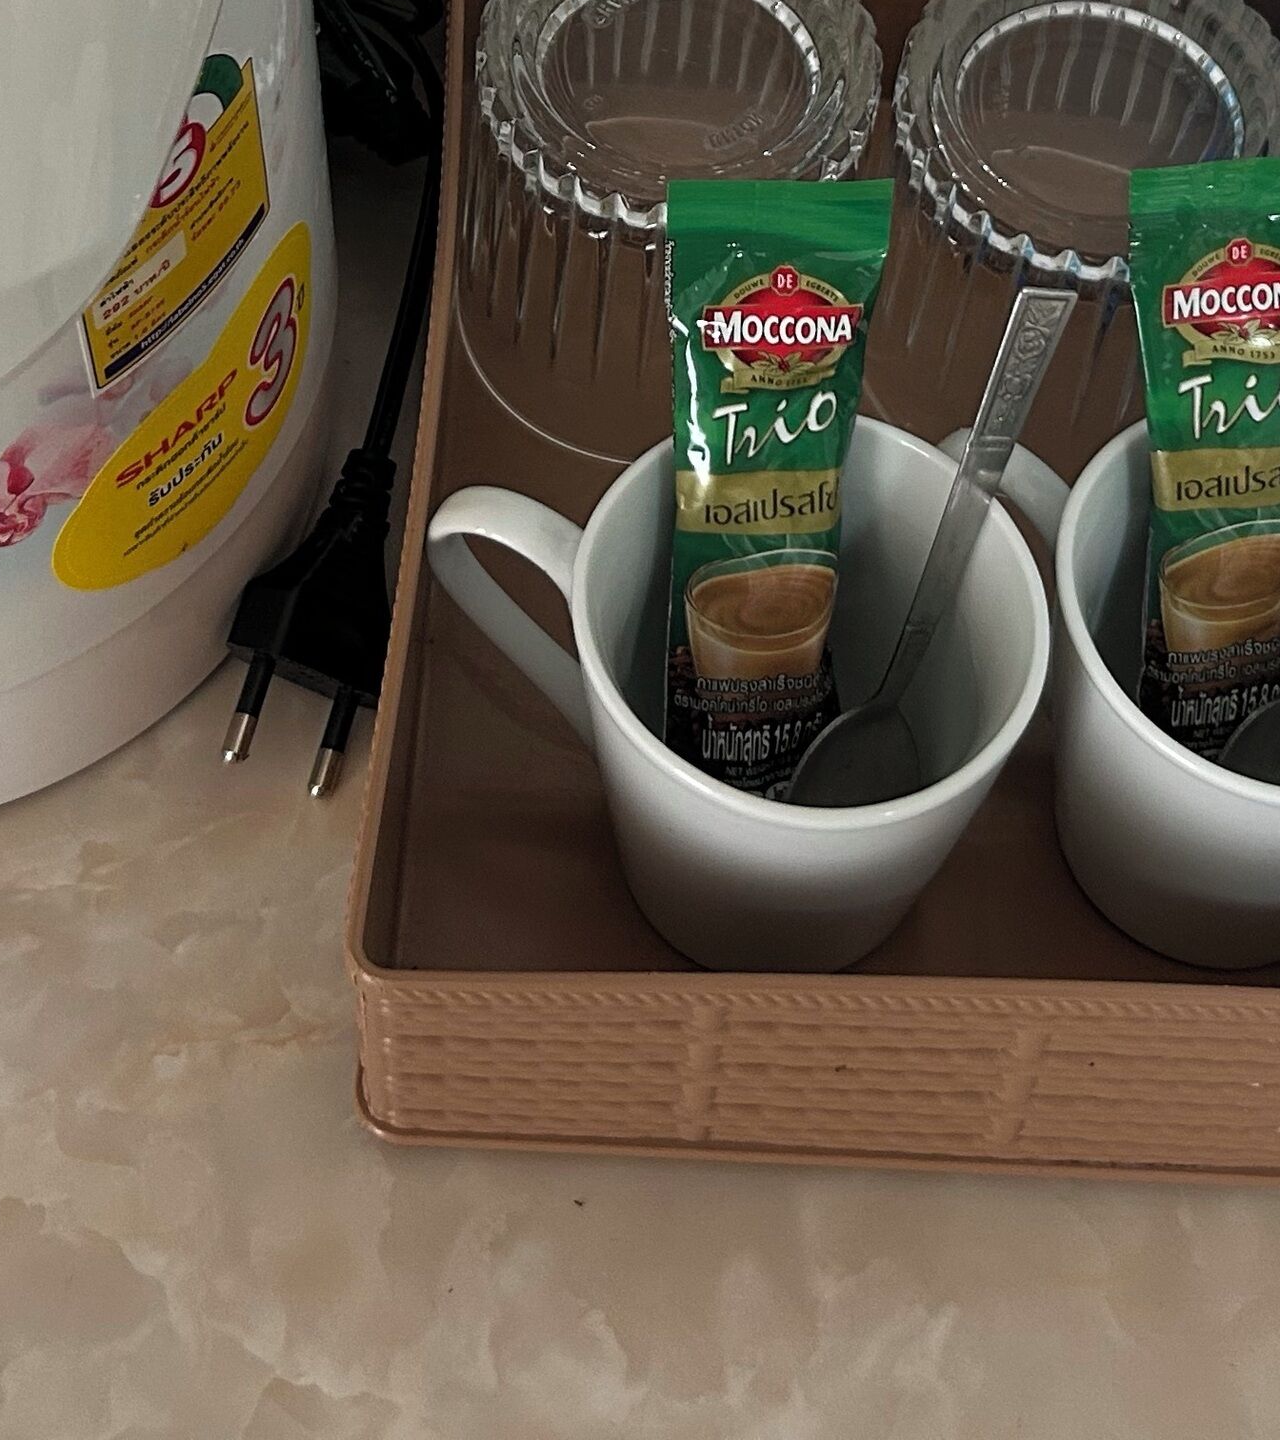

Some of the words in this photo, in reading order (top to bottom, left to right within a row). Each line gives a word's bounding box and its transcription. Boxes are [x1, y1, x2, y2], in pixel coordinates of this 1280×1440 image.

[245, 276, 298, 427] 3
[713, 310, 852, 345] MOCCONA
[1212, 345, 1246, 357] ANNO
[115, 368, 238, 490] SHARP
[711, 389, 838, 466] Trio
[148, 432, 224, 508] รับประกัน
